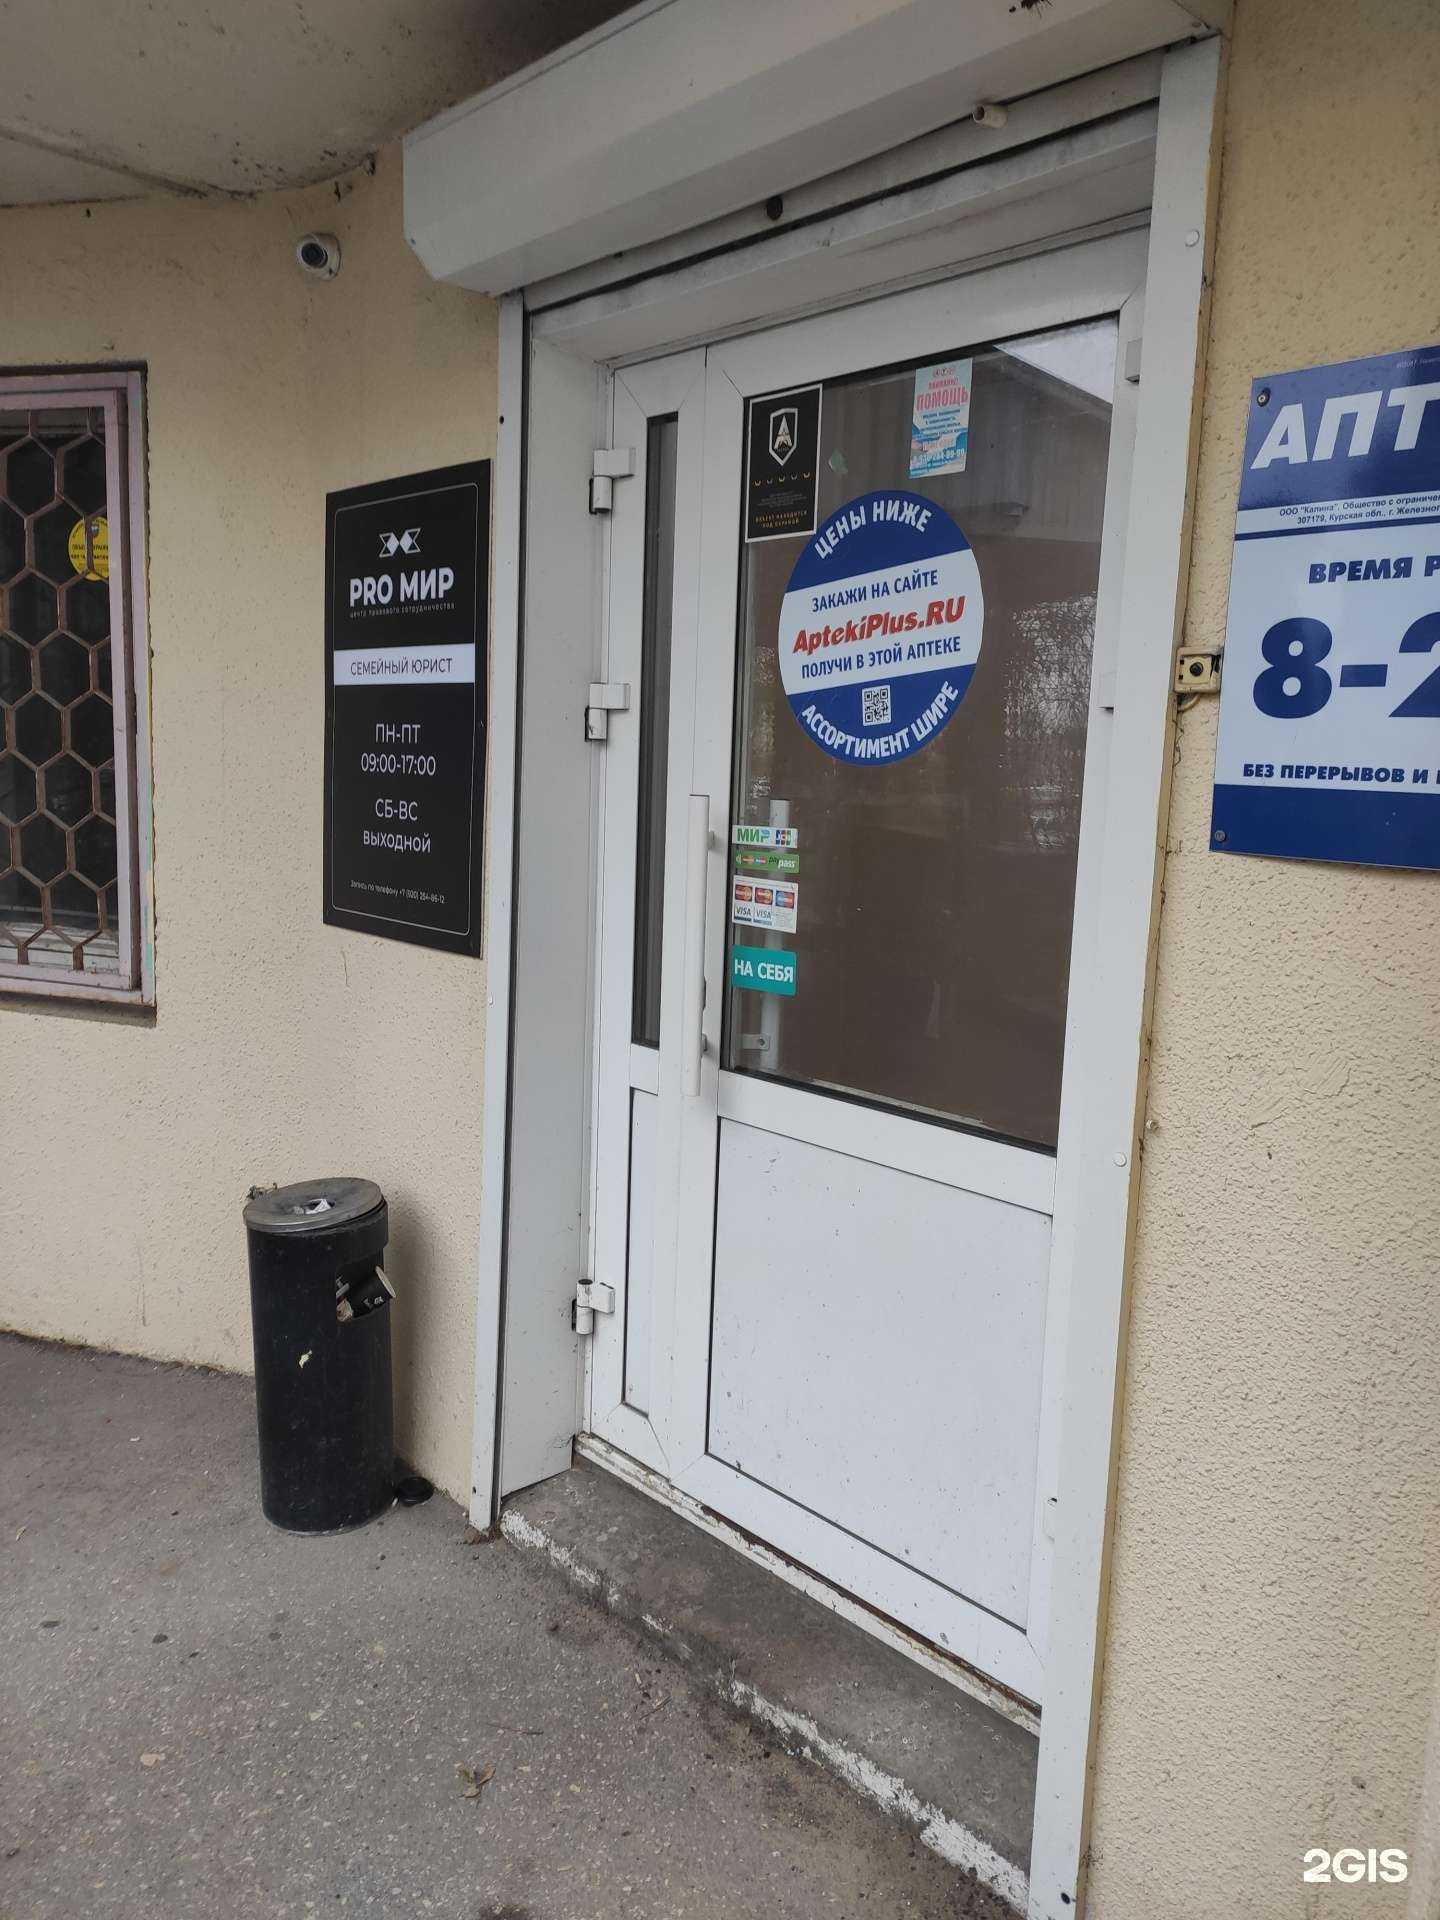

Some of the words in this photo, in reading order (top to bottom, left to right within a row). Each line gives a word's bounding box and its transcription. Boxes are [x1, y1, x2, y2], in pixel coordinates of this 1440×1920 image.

[915, 386, 969, 412] ПОМОЩЬ
[1251, 382, 1440, 469] АПТ
[1280, 507, 1298, 517] ООО
[1343, 499, 1386, 510] Общество
[1329, 512, 1362, 523] Курская
[814, 505, 866, 559] ЦЕНЫ
[872, 499, 932, 532] НИЖЕ
[1309, 557, 1412, 584] ВРЕМЯ
[350, 574, 393, 607] PRO
[400, 567, 455, 602] МИР
[812, 586, 867, 613] ЗАКАЖИ
[871, 583, 890, 600] НА
[894, 569, 938, 594] САЙТЕ
[793, 596, 966, 656] AptekiPlus.RU
[350, 657, 409, 676] СЕМЕЙНЫЙ
[412, 657, 453, 673] ЮРИСТ
[801, 655, 851, 679] ПОЛУЧИ
[856, 652, 864, 669] В
[868, 643, 902, 666] ЭТОЙ
[907, 636, 961, 661] АПТЕКЕ
[801, 704, 909, 759] АССОРТИМЕНТ
[909, 680, 959, 741] ШИРЕ
[375, 724, 420, 744] ПН-ПТ
[361, 752, 436, 776] 09:00-17:00
[1243, 763, 1274, 778] БЕЗ
[1280, 764, 1405, 783] ПЕРЕРЫВОВ
[1412, 769, 1428, 783] И
[375, 798, 418, 821] СБ-ВС
[363, 830, 431, 853] ВЫХОДНОЙ
[737, 828, 770, 843] МИР
[734, 959, 753, 977] НА
[758, 962, 794, 983] СЕБЯ
